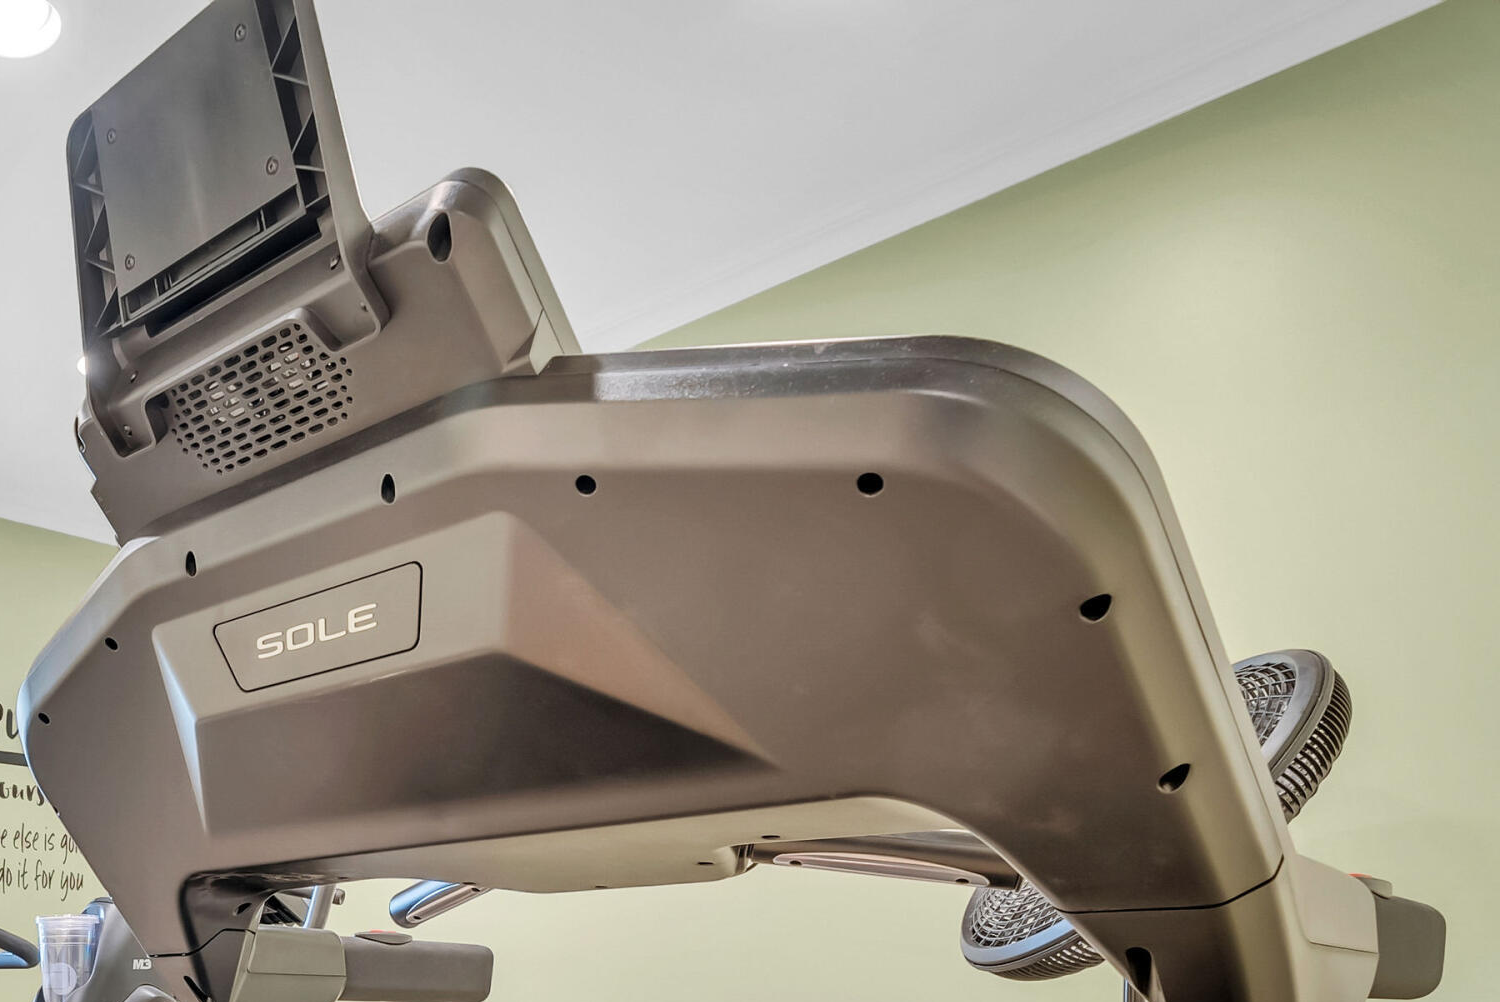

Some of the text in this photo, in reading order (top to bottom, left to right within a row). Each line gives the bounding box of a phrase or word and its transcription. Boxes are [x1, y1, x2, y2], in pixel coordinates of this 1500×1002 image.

[256, 603, 377, 659] SOLE
[13, 822, 40, 854] else
[44, 826, 55, 851] is
[17, 858, 29, 891] it
[34, 858, 56, 891] for
[61, 870, 84, 902] you
